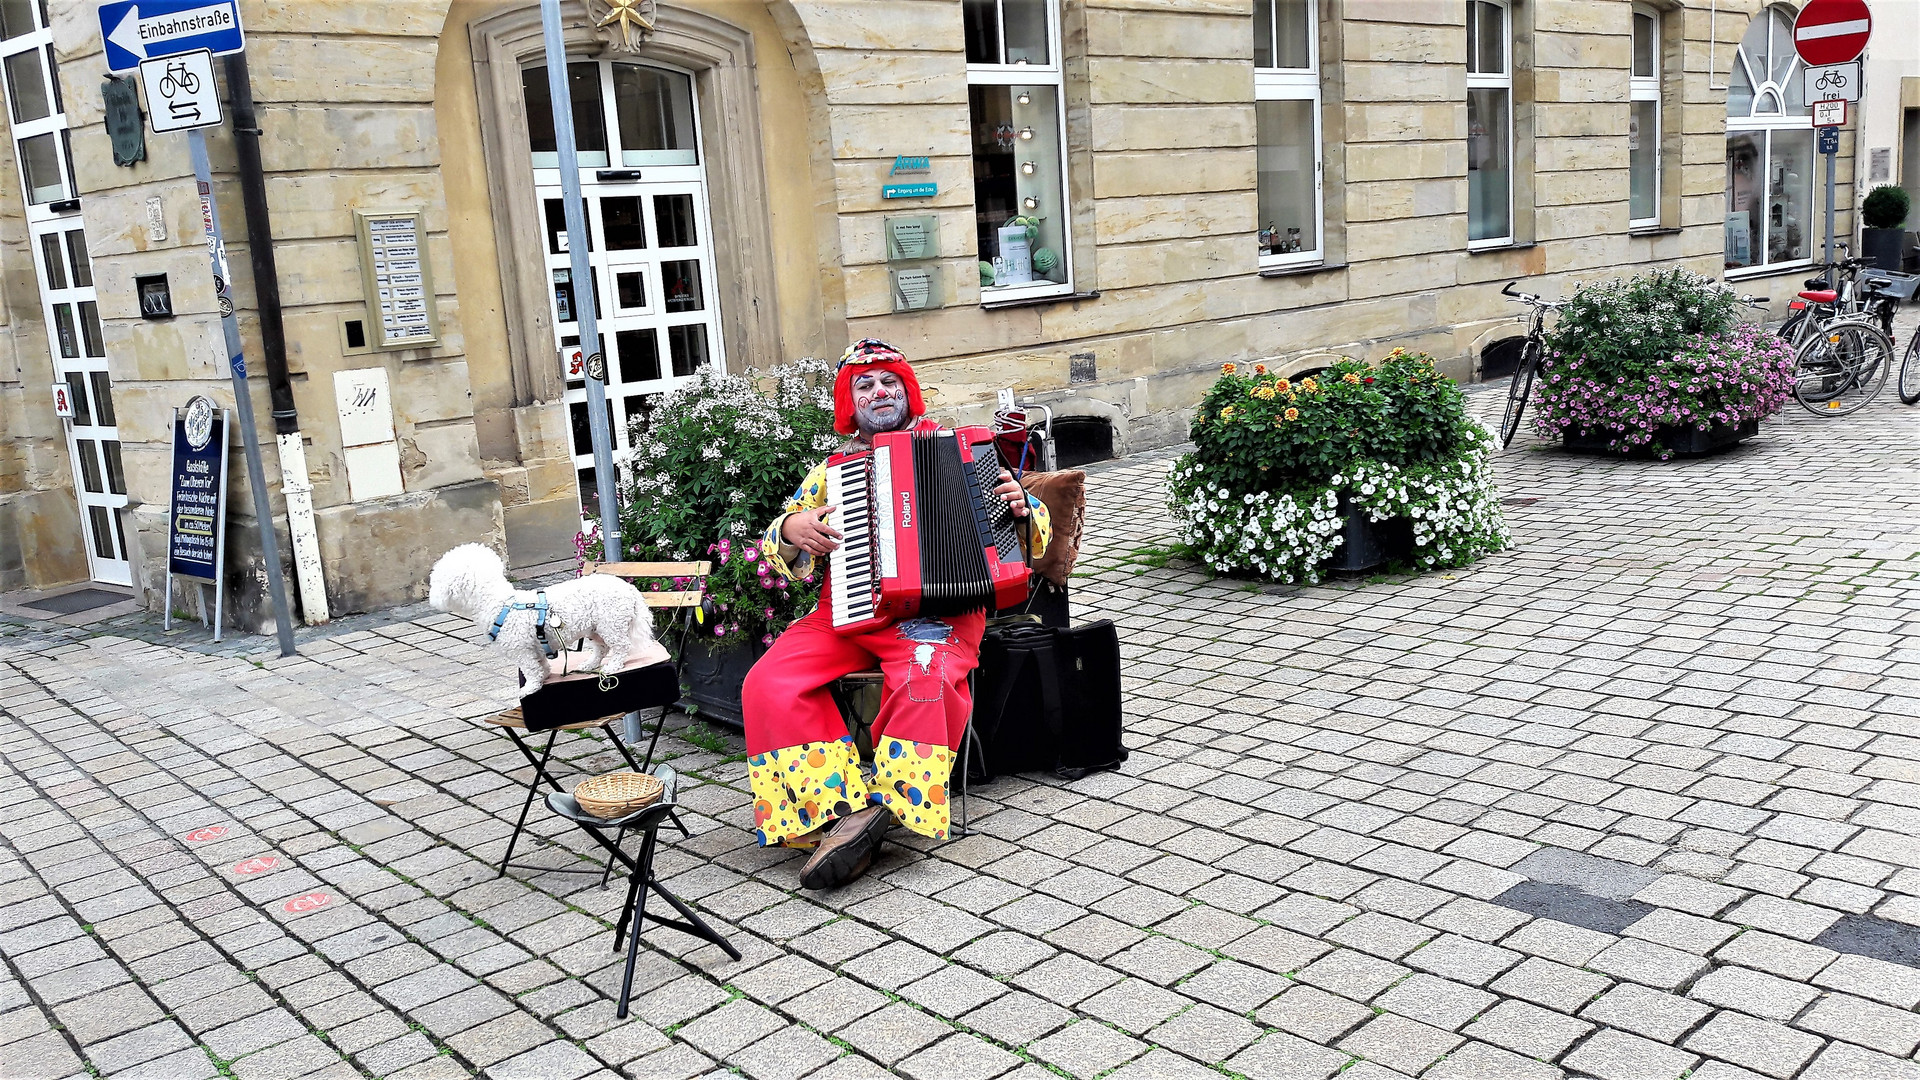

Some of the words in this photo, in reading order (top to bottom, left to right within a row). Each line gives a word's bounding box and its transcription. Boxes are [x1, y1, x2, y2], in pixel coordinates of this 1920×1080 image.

[139, 10, 230, 40] Einbahnstraße
[1823, 90, 1840, 100] frei
[889, 154, 930, 176] ARWA
[176, 503, 184, 514] der
[900, 491, 912, 528] Roland
